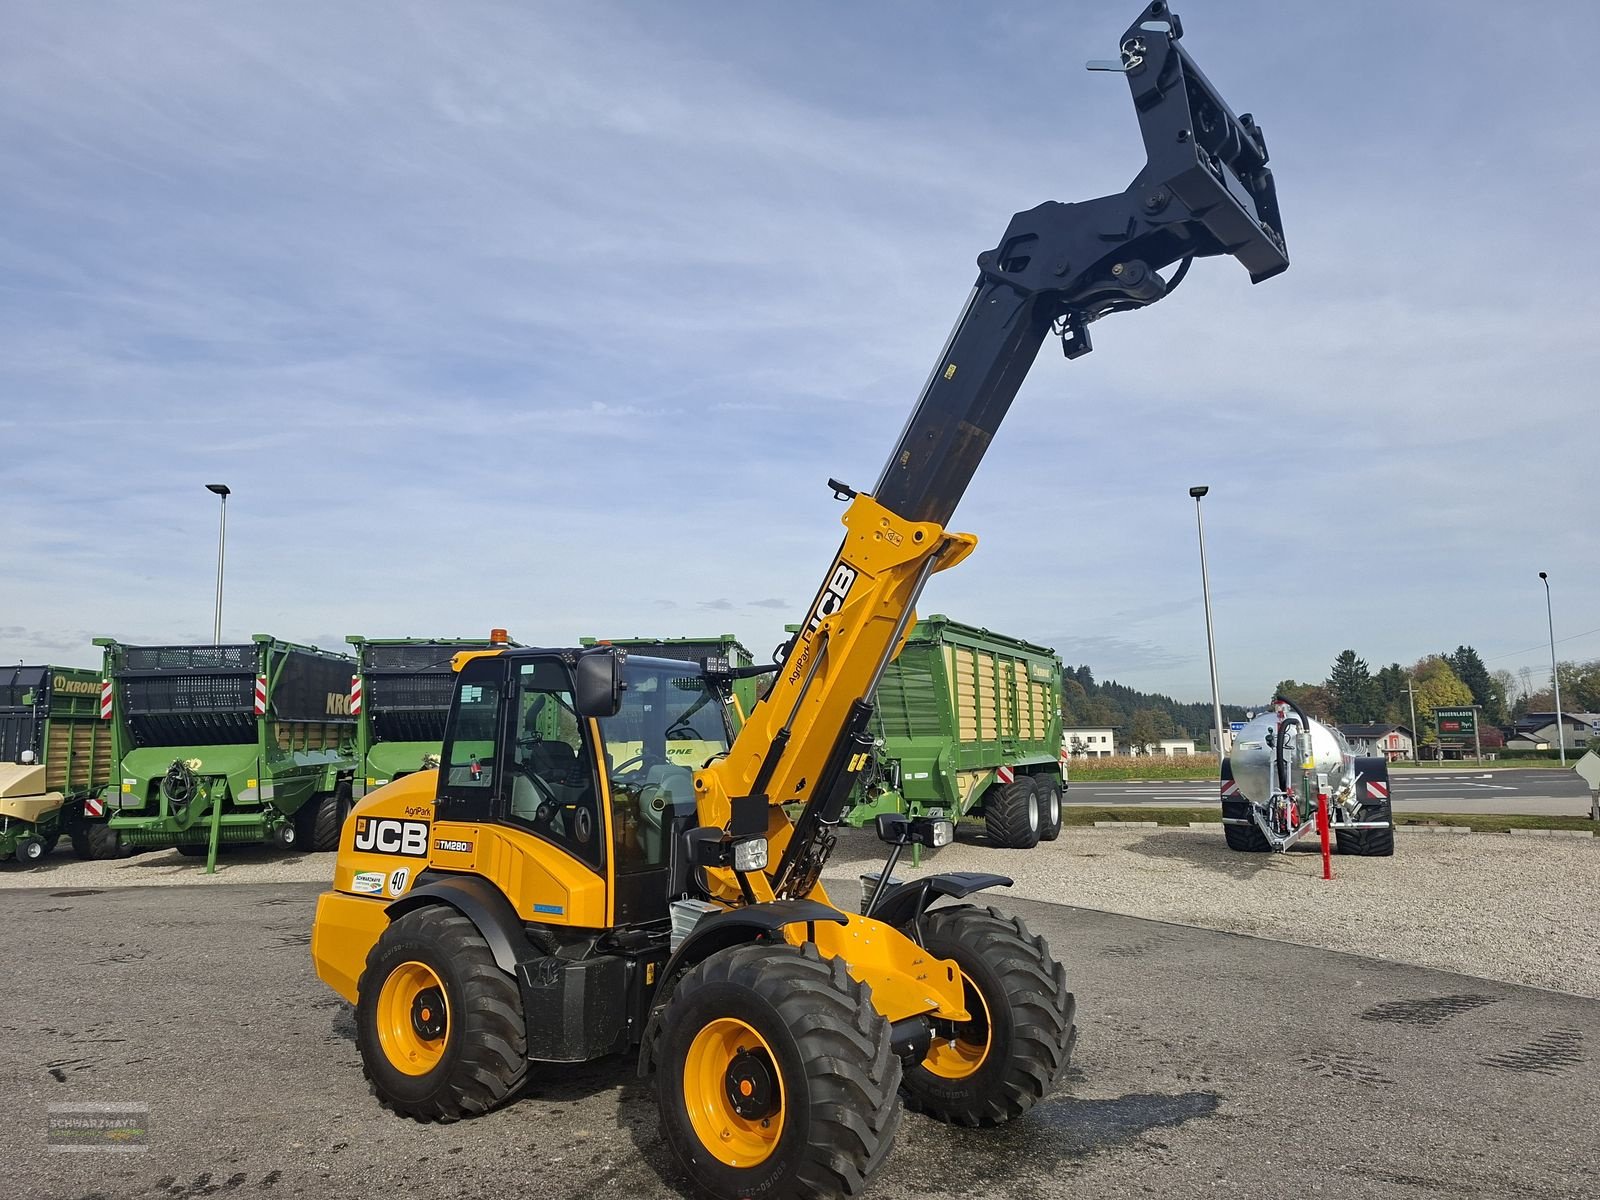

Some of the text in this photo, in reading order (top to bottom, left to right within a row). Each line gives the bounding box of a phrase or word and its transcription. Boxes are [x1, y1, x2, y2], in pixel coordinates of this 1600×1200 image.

[789, 645, 810, 685] AgriPark
[65, 680, 103, 694] KRONE
[325, 692, 352, 716] KRO
[405, 806, 431, 817] AgriPark
[356, 820, 428, 855] JCB
[392, 871, 405, 890] 40
